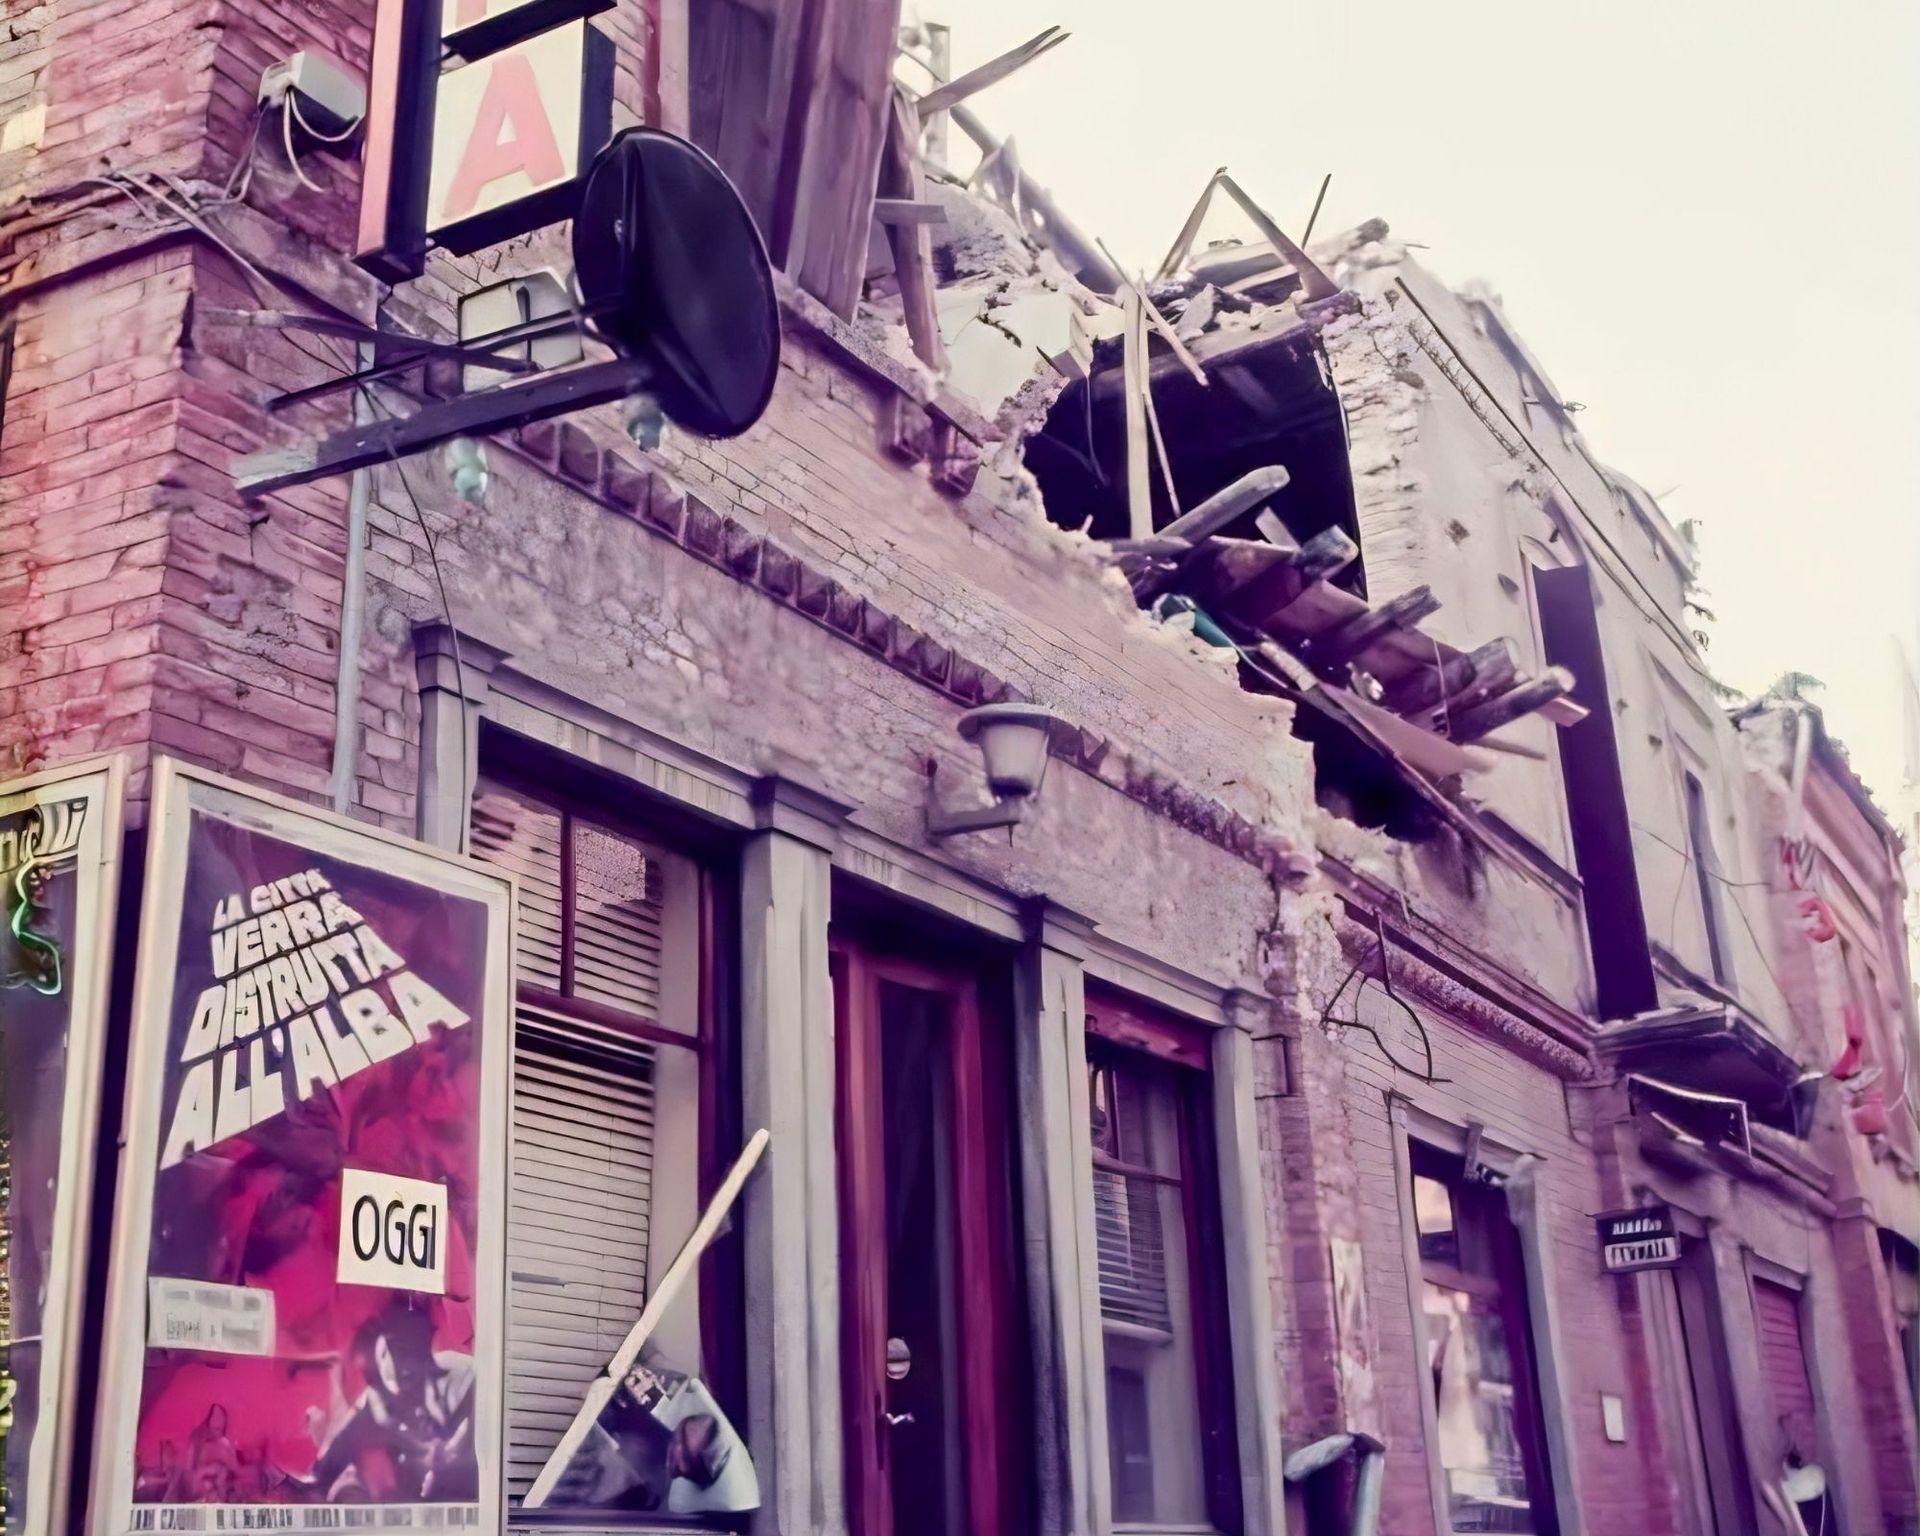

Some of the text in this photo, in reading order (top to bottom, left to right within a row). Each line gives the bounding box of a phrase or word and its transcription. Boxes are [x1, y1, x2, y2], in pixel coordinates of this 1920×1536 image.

[180, 924, 406, 1063] DISTRUTTA
[160, 971, 471, 1170] ALL'ALBA
[352, 1195, 437, 1270] OGGI
